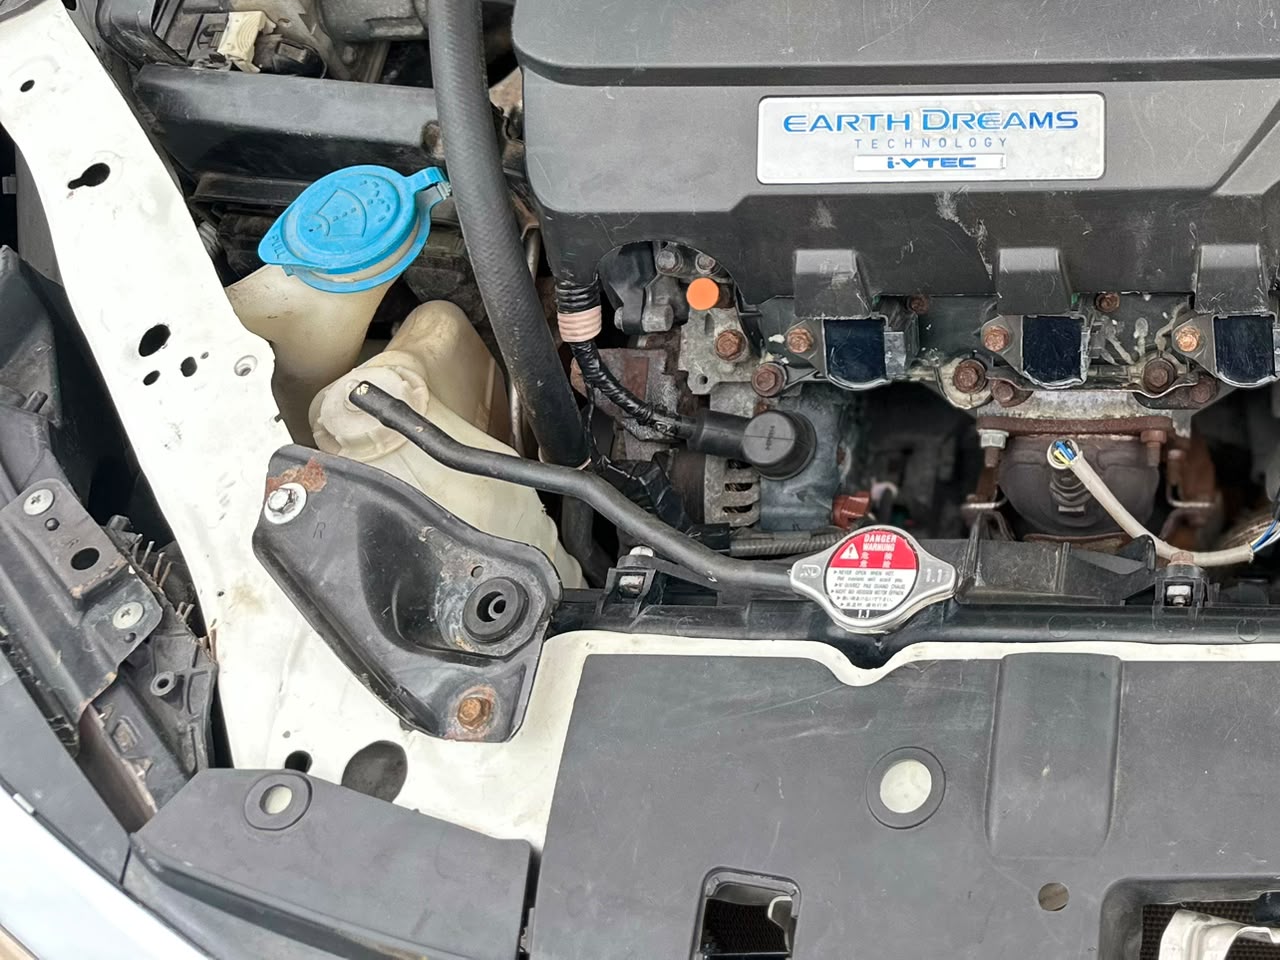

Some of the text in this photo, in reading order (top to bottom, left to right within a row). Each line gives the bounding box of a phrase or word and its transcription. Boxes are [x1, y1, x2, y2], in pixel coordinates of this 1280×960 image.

[783, 108, 1079, 133] EARTH DREAMS
[855, 137, 1007, 150] TECHNOLOGY
[887, 156, 976, 169] i-VTEC
[863, 534, 897, 543] DANGER
